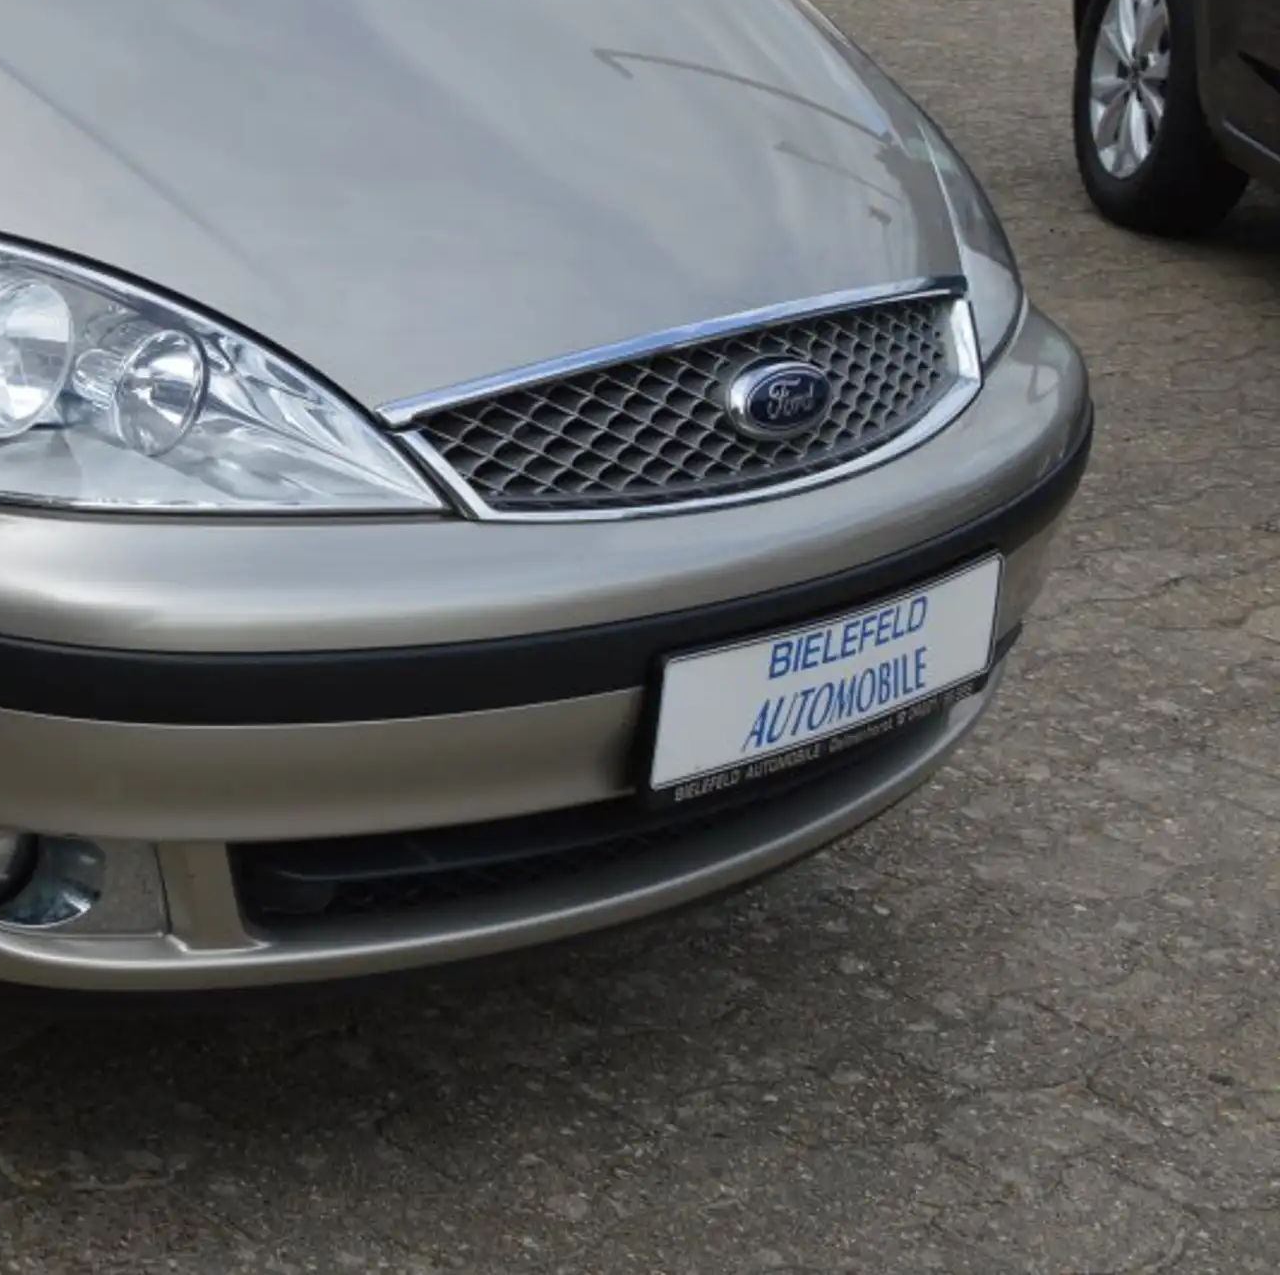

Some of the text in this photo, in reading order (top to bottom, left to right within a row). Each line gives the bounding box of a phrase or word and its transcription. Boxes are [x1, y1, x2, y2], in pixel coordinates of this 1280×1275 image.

[766, 379, 815, 420] Ford
[767, 595, 928, 681] BIELEFELD
[741, 646, 927, 753] AUTOMOBILE
[674, 770, 741, 802] BIELEFELD
[745, 743, 824, 781] AUTOMOBILE
